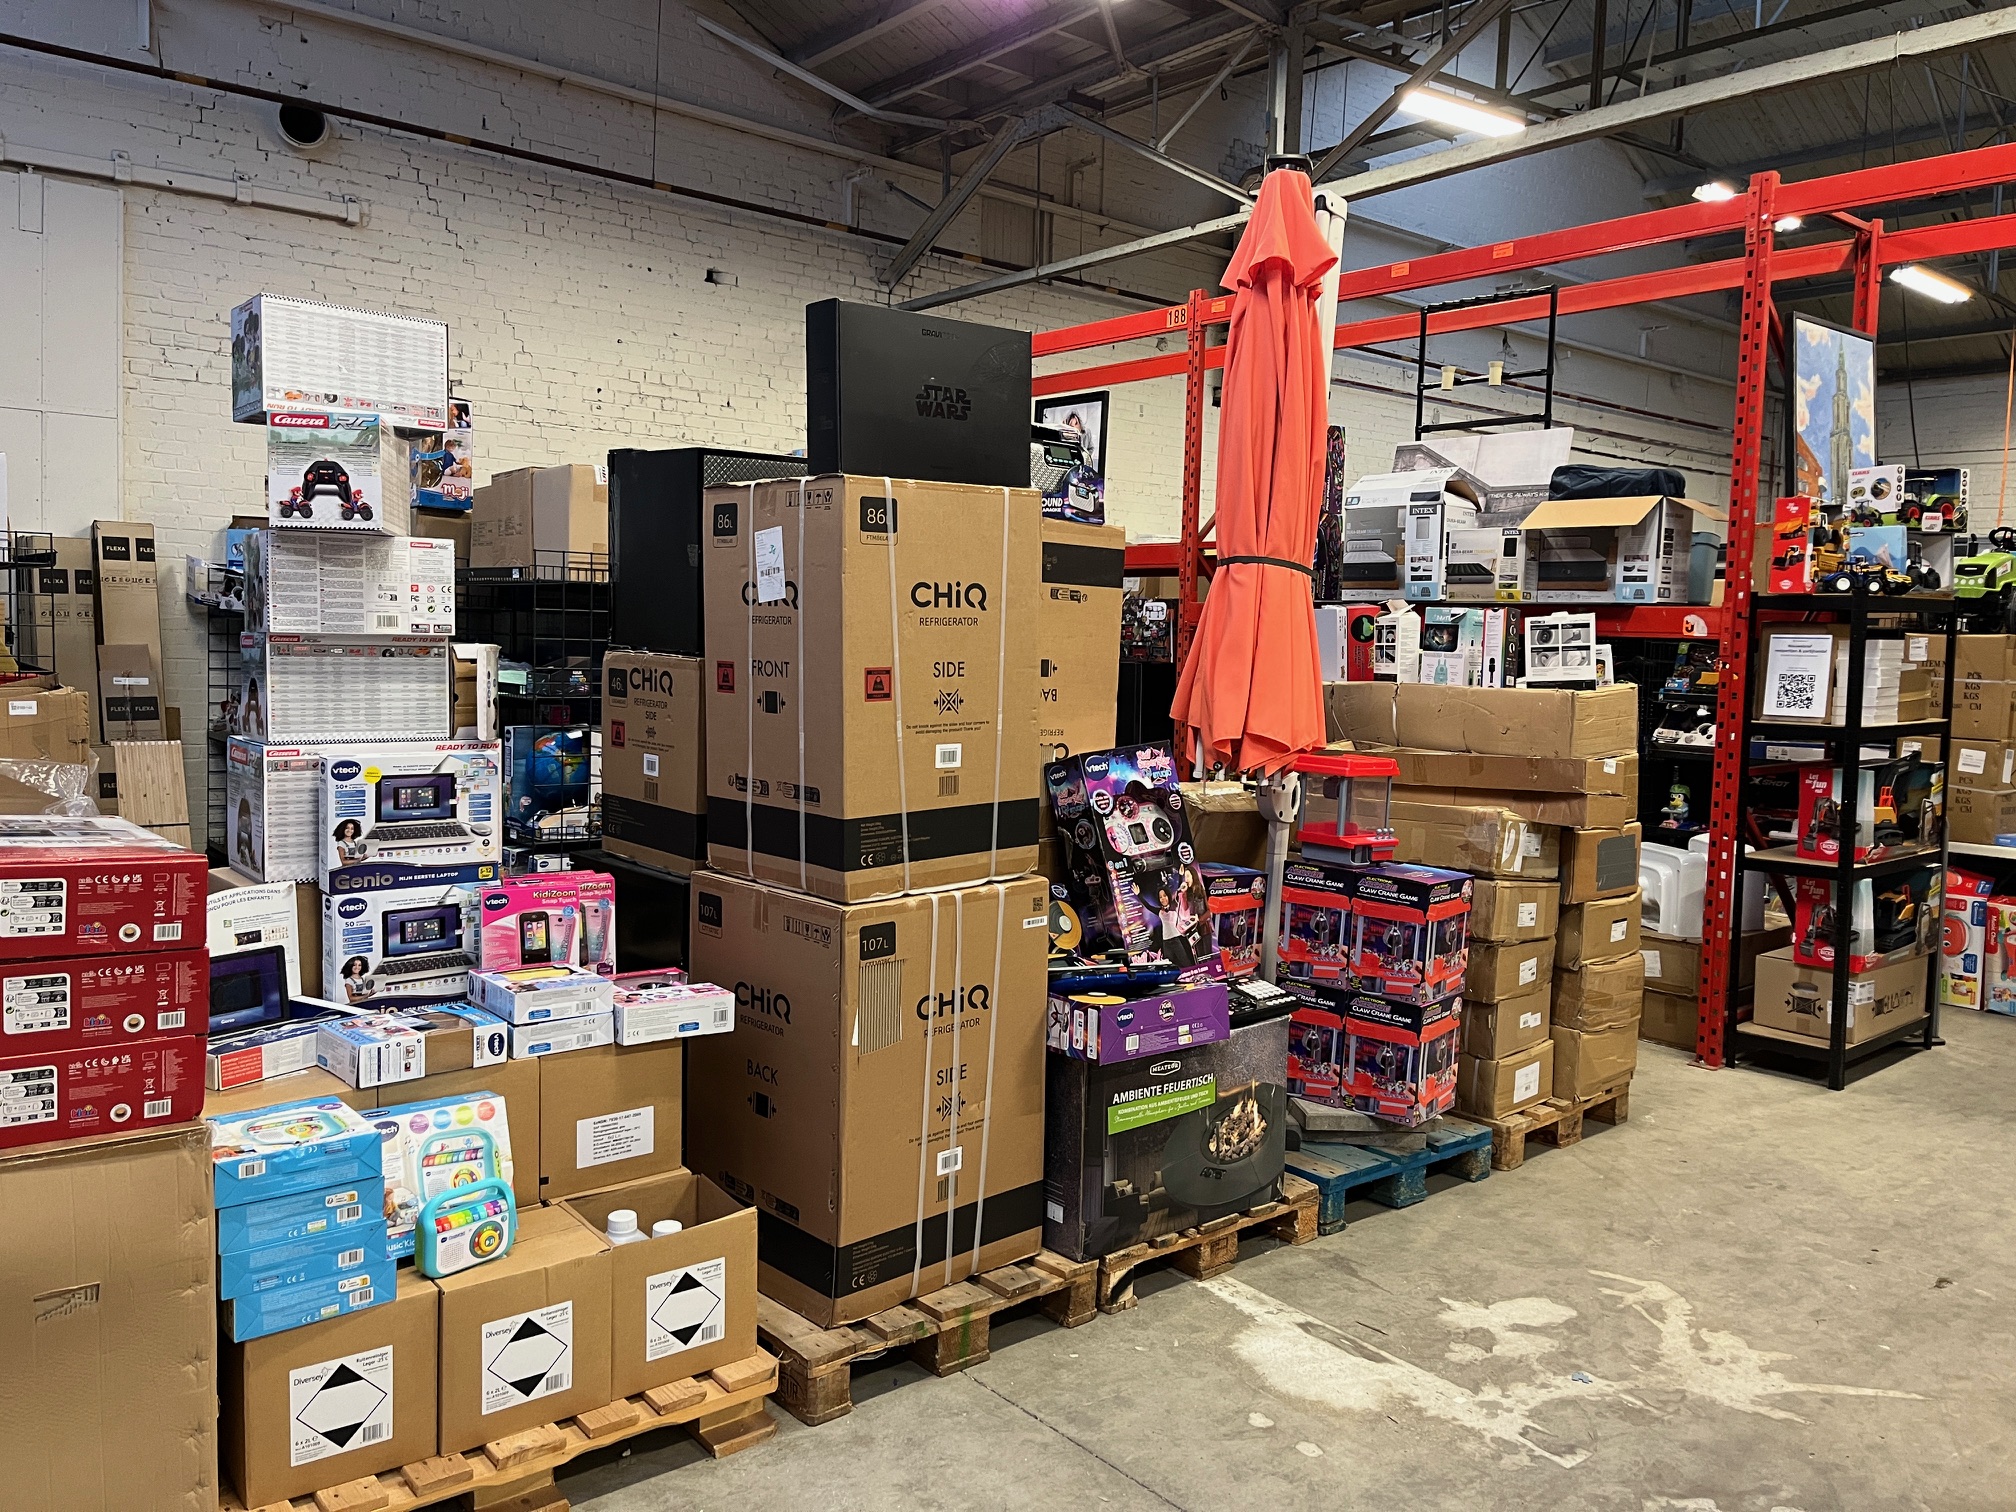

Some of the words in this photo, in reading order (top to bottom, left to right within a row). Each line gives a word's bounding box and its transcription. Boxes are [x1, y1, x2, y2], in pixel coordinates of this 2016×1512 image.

[1168, 308, 1187, 325] 188
[916, 384, 971, 405] STAR
[916, 400, 971, 421] WARS
[273, 414, 326, 427] Carrera
[910, 581, 988, 611] CHiQ
[749, 614, 792, 626] EFRIGERATOR
[918, 616, 979, 628] REFRIGERATOR
[270, 635, 300, 643] Carrera
[751, 660, 790, 678] FRONT
[933, 661, 965, 678] SIDE
[629, 667, 673, 697] CHiQ
[633, 697, 668, 709] REFRIGERATOR
[645, 711, 658, 721] SIDE
[268, 749, 299, 757] Carrera
[333, 765, 361, 774] vtech
[1086, 761, 1109, 773] vtech
[1049, 769, 1066, 779] vtech
[1812, 779, 1827, 789] fun
[1955, 796, 1971, 804] KGS
[335, 872, 394, 890] Genio
[1287, 874, 1305, 882] CLAW
[1306, 876, 1325, 885] CRANE
[1326, 880, 1345, 888] GAME
[228, 889, 266, 900] APPLICATIONS
[533, 889, 577, 900] KidiZoom
[1359, 886, 1376, 894] CLAW
[1377, 889, 1399, 899] CRANE
[1400, 893, 1419, 902] GAME
[485, 897, 508, 906] vtech
[558, 896, 577, 905] Touch
[338, 902, 367, 912] vtech
[861, 937, 889, 951] 107L
[416, 1003, 442, 1011] PREMIER
[1320, 997, 1336, 1006] GAME
[1117, 1012, 1134, 1022] vtech
[1352, 1005, 1370, 1014] CLAW
[1371, 1009, 1392, 1018] CRANE
[1392, 1014, 1412, 1024] GAME
[740, 1014, 784, 1037] REFRIGERATOR
[924, 1017, 981, 1039] RFRIGEATOR
[492, 1033, 502, 1057] vtech
[746, 1058, 779, 1086] BACK
[1113, 1085, 1163, 1104] AMBIENTE
[1163, 1073, 1214, 1095] FEUERTISCH
[1118, 1103, 1148, 1115] KOMBINATION
[1158, 1094, 1190, 1107] AMBIENTEFEUER
[650, 1280, 673, 1291] Diversey
[485, 1328, 513, 1339] Diversey
[293, 1374, 324, 1387] Diversey
